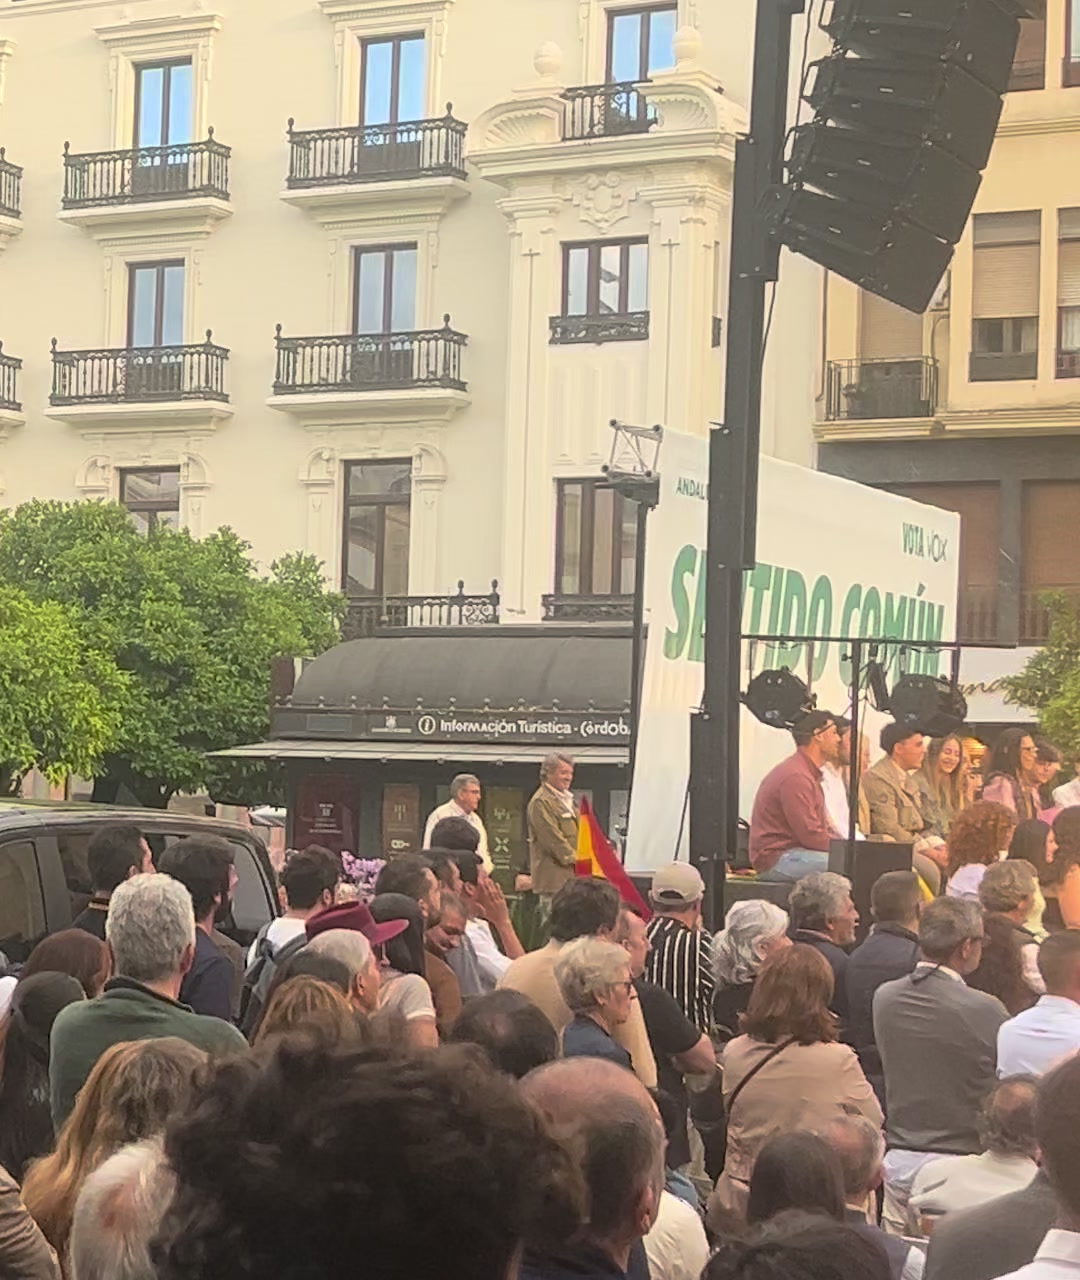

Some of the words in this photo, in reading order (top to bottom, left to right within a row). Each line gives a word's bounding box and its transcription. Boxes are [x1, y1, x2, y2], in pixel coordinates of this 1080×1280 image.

[902, 521, 924, 557] VOTA
[926, 528, 948, 563] VOX
[663, 543, 832, 682] STIDO
[837, 583, 945, 687] COMÚN
[517, 717, 572, 734] Turística
[580, 716, 631, 738] Córdob
